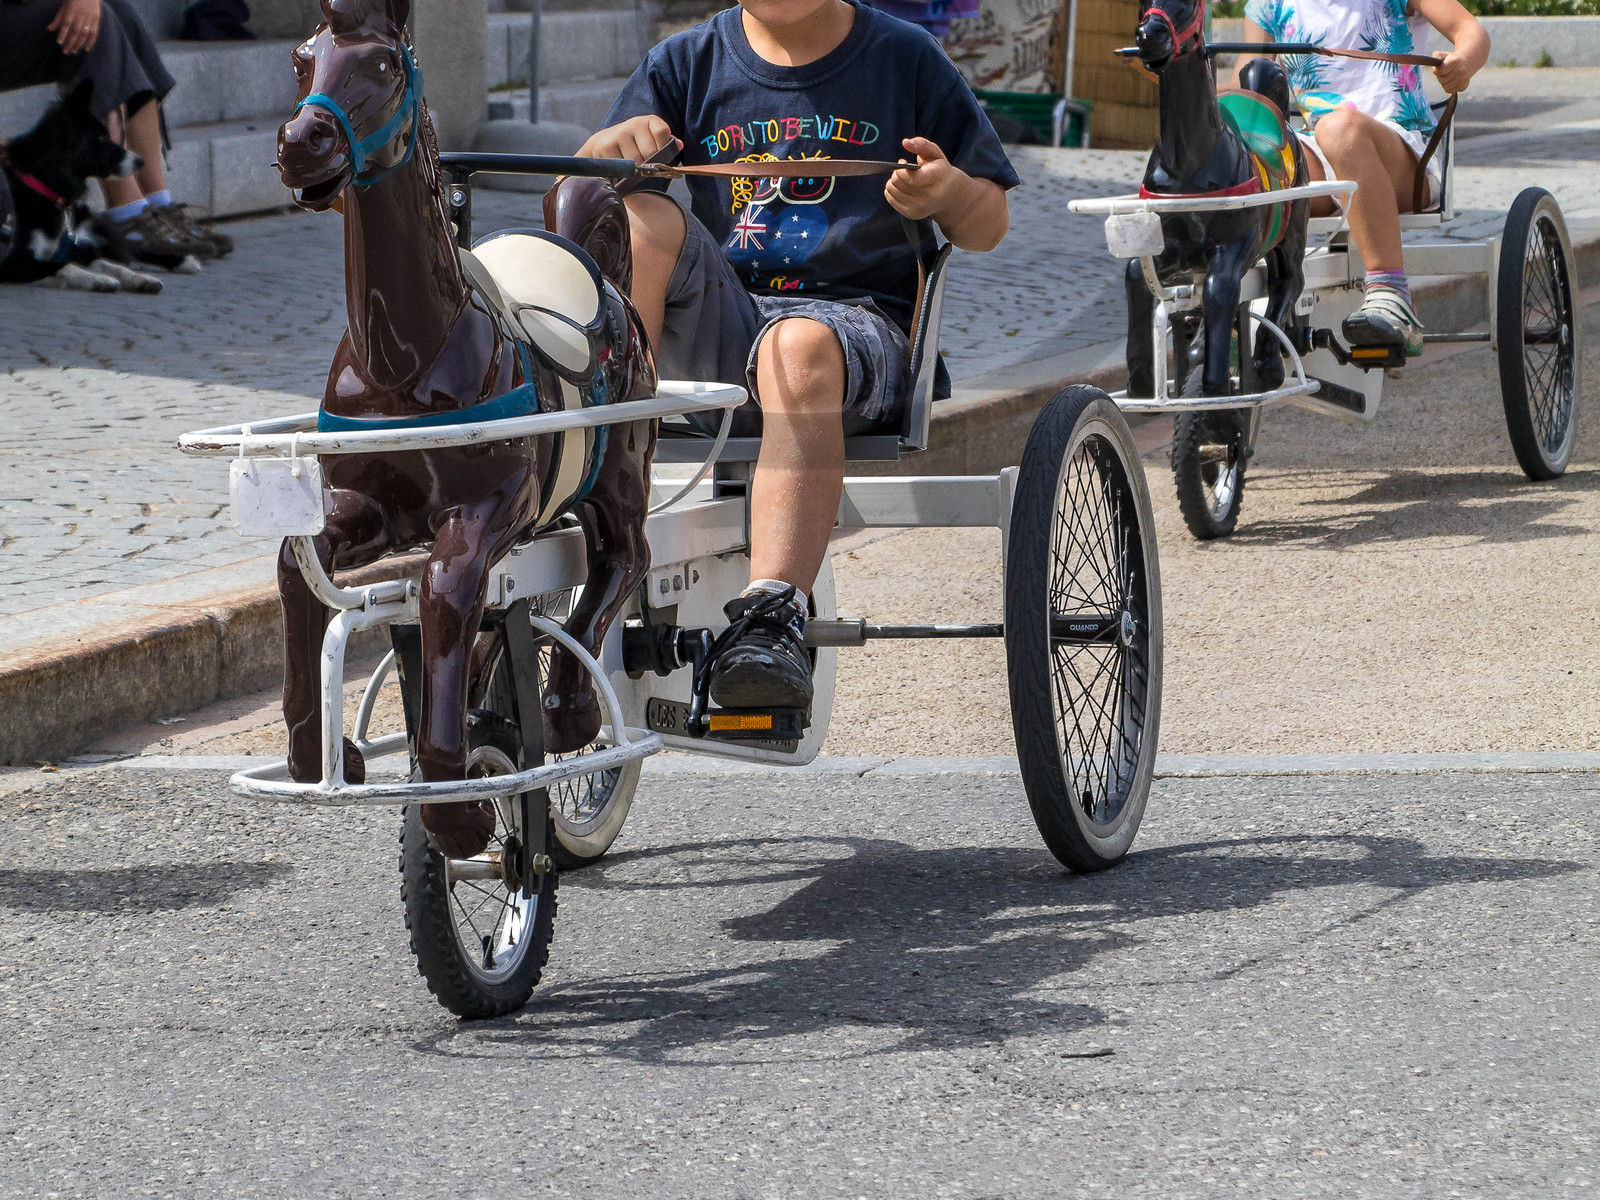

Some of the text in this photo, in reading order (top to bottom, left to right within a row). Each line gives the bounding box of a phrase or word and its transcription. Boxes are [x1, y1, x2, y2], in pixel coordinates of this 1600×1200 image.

[700, 114, 880, 158] BORN TO BE WILD
[1069, 623, 1099, 631] QUANDO
[656, 703, 676, 728] LES
